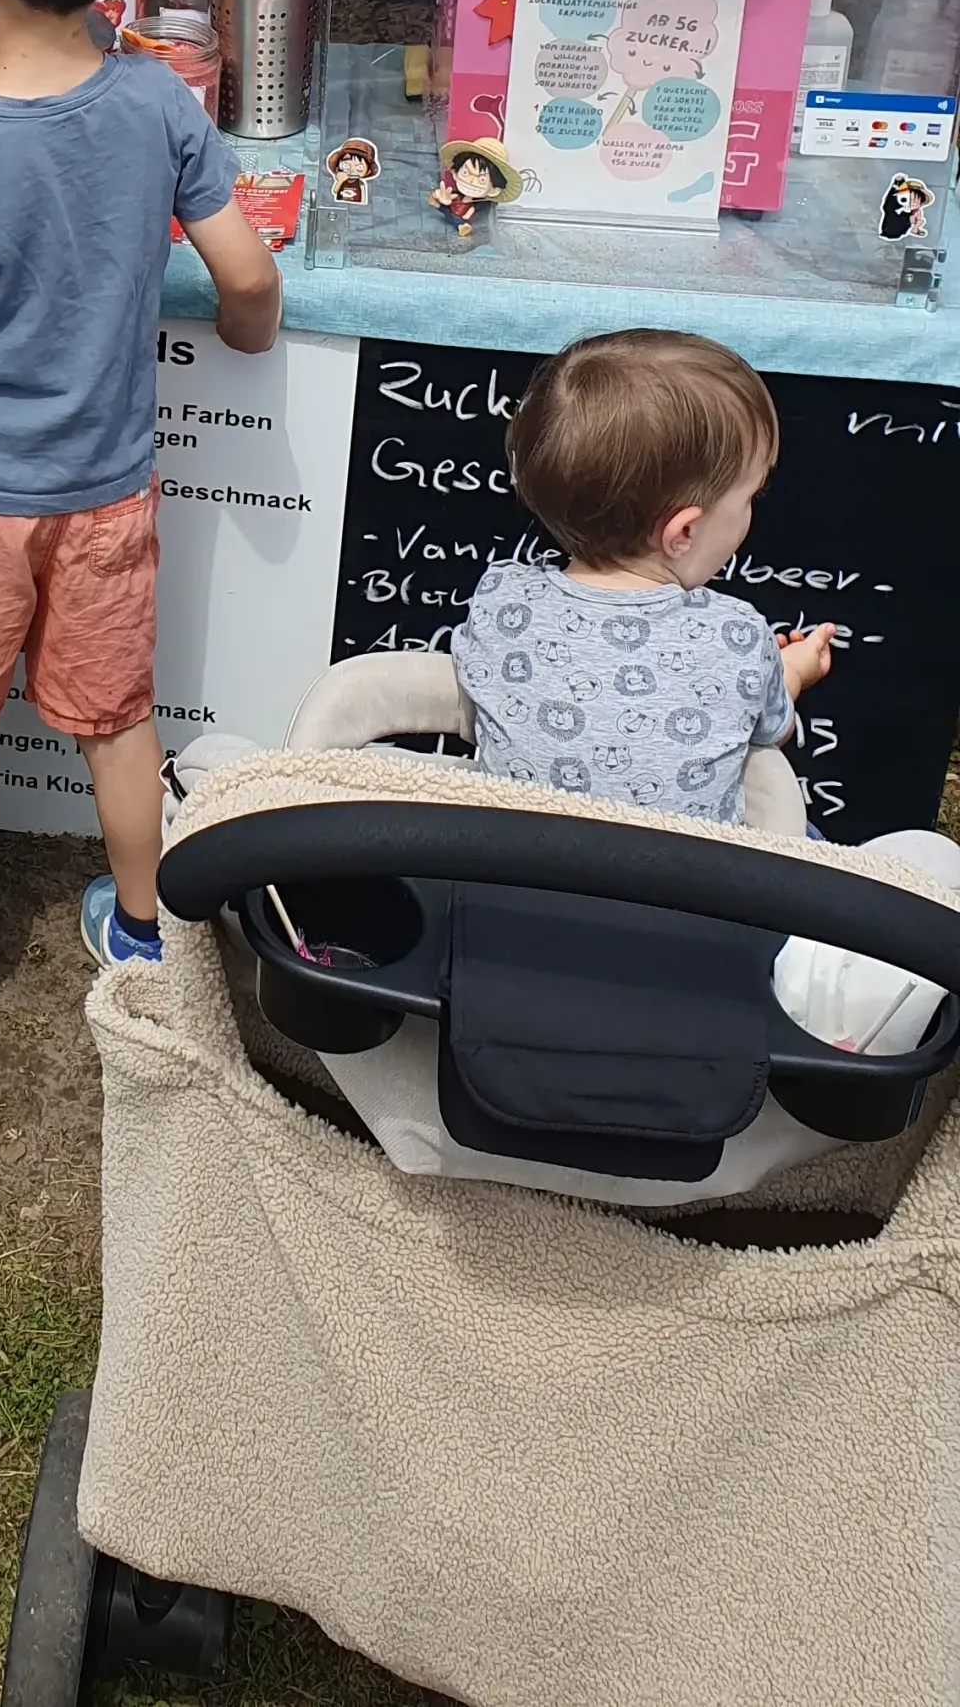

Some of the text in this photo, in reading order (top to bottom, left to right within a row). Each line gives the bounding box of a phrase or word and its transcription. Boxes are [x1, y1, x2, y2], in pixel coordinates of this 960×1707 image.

[558, 8, 605, 19] ERFUNDEN
[646, 13, 698, 32] AB 5G
[539, 43, 603, 53] VOM ZAHNARZT
[553, 53, 587, 62] WILLIAM
[538, 62, 581, 71] MORRISON
[538, 71, 597, 81] DEM KONDITOR
[534, 80, 598, 90] JOHN WHARTON
[533, 103, 539, 112] 1
[568, 106, 603, 116] HARIBO
[653, 104, 675, 113] KANN
[678, 106, 691, 114] BIS
[583, 118, 597, 127] AB
[672, 116, 703, 124] ZUCKER
[558, 128, 595, 138] ZUCKER
[602, 139, 635, 149] WASSER
[655, 143, 684, 151] AROMA
[902, 140, 914, 148] Pay
[928, 141, 940, 149] Pay
[652, 152, 664, 160] AB
[629, 160, 661, 169] ZUCKER
[378, 361, 522, 421] Zuck
[182, 404, 272, 430] Farben
[161, 479, 312, 512] Geschmack
